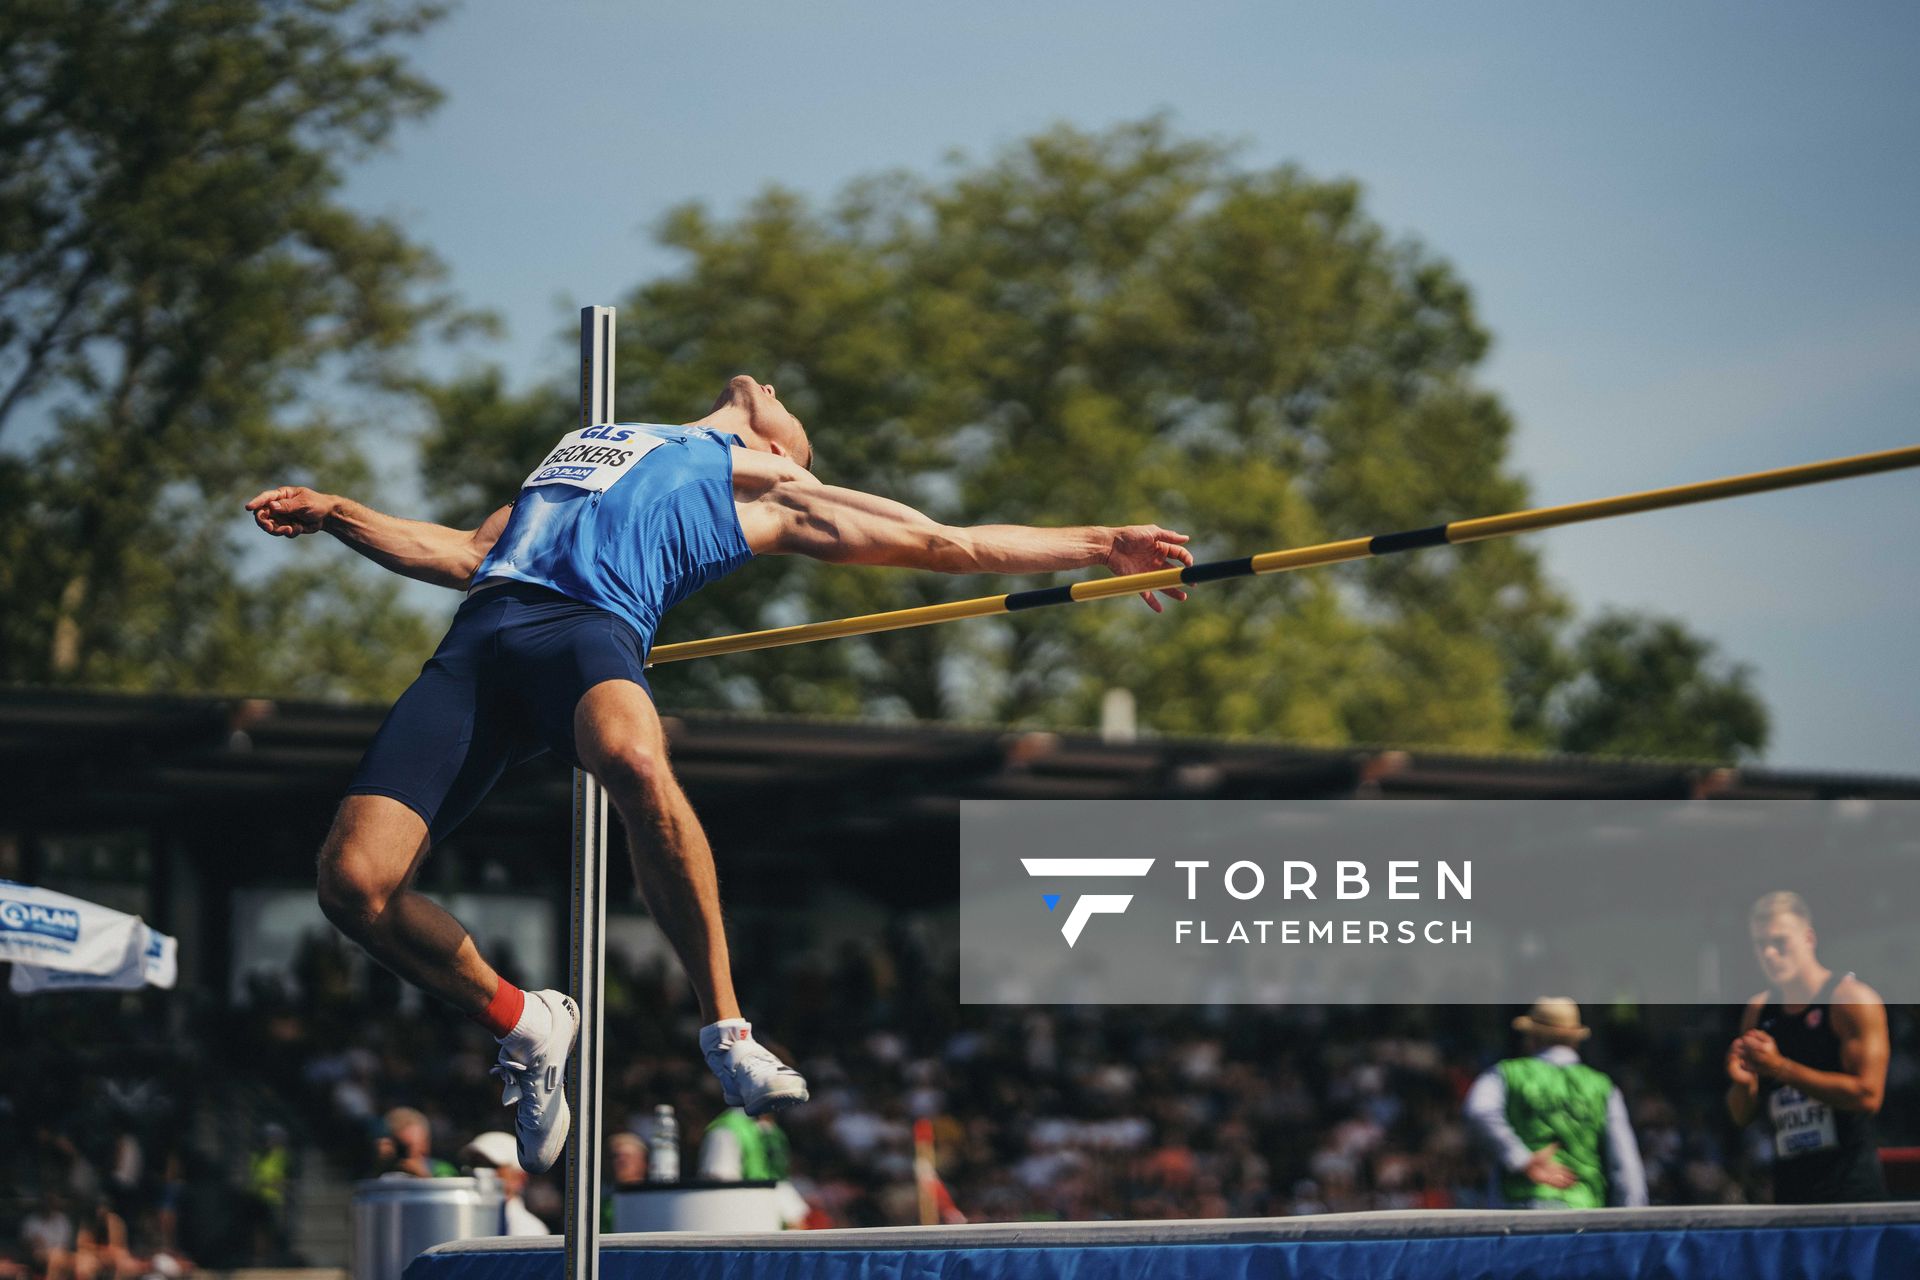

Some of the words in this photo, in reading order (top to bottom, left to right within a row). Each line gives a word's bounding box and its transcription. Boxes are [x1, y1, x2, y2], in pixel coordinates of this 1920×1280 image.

[543, 444, 634, 467] BECKERS
[557, 467, 592, 476] PLAN
[31, 905, 77, 928] PLAN
